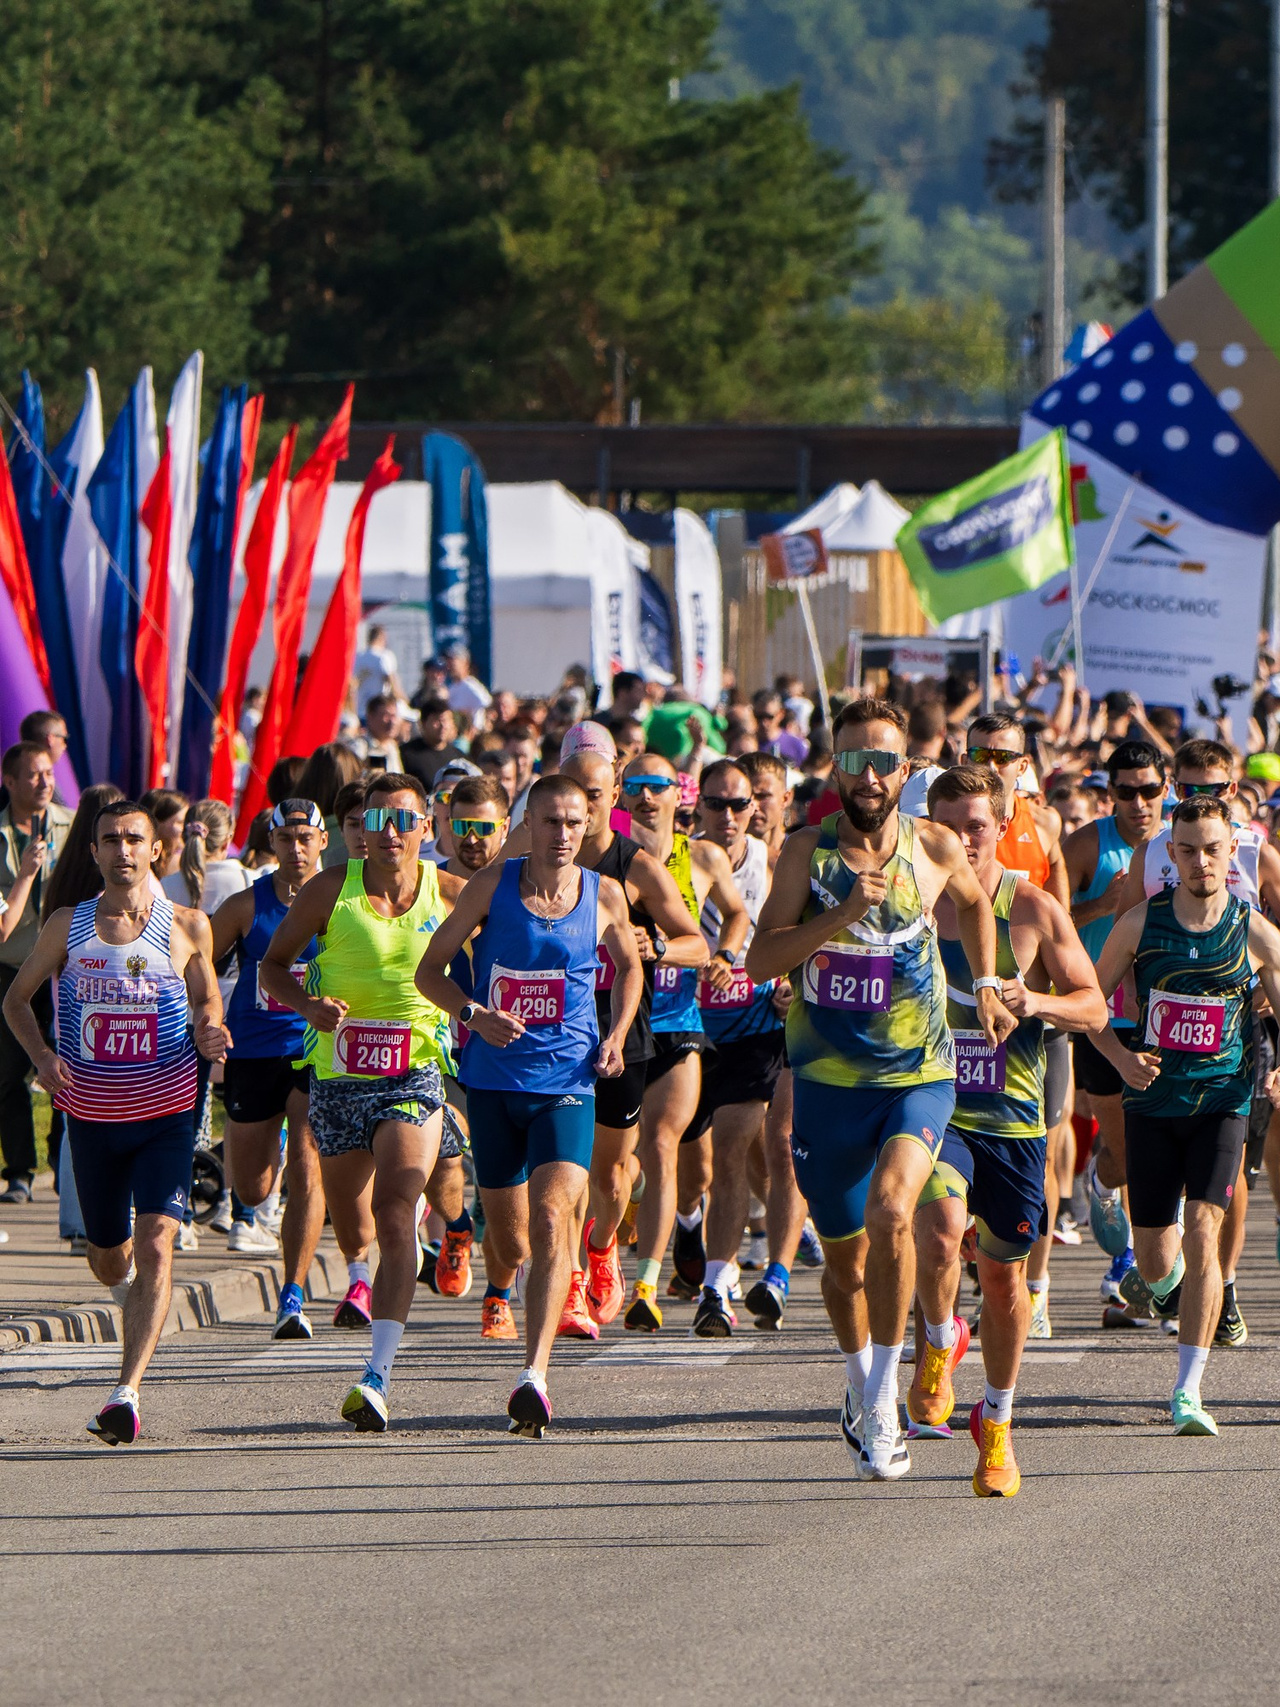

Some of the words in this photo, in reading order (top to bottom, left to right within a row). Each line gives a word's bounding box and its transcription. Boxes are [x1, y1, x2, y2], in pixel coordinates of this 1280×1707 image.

[1088, 588, 1220, 618] РОСКОСМОС
[82, 958, 108, 970] RAY
[657, 967, 678, 988] 19
[520, 984, 549, 995] СЕРГЕЙ
[829, 974, 884, 1004] 5210
[509, 997, 557, 1018] 4296
[1181, 1008, 1208, 1022] АРТЁМ
[109, 1018, 148, 1031] ДМИТРИЙ
[1168, 1021, 1216, 1046] 4033
[104, 1032, 152, 1056] 4714
[357, 1032, 406, 1046] АЛЕКСАНДР
[356, 1045, 403, 1070] 2491
[955, 1045, 997, 1058] ЛАДИМИР
